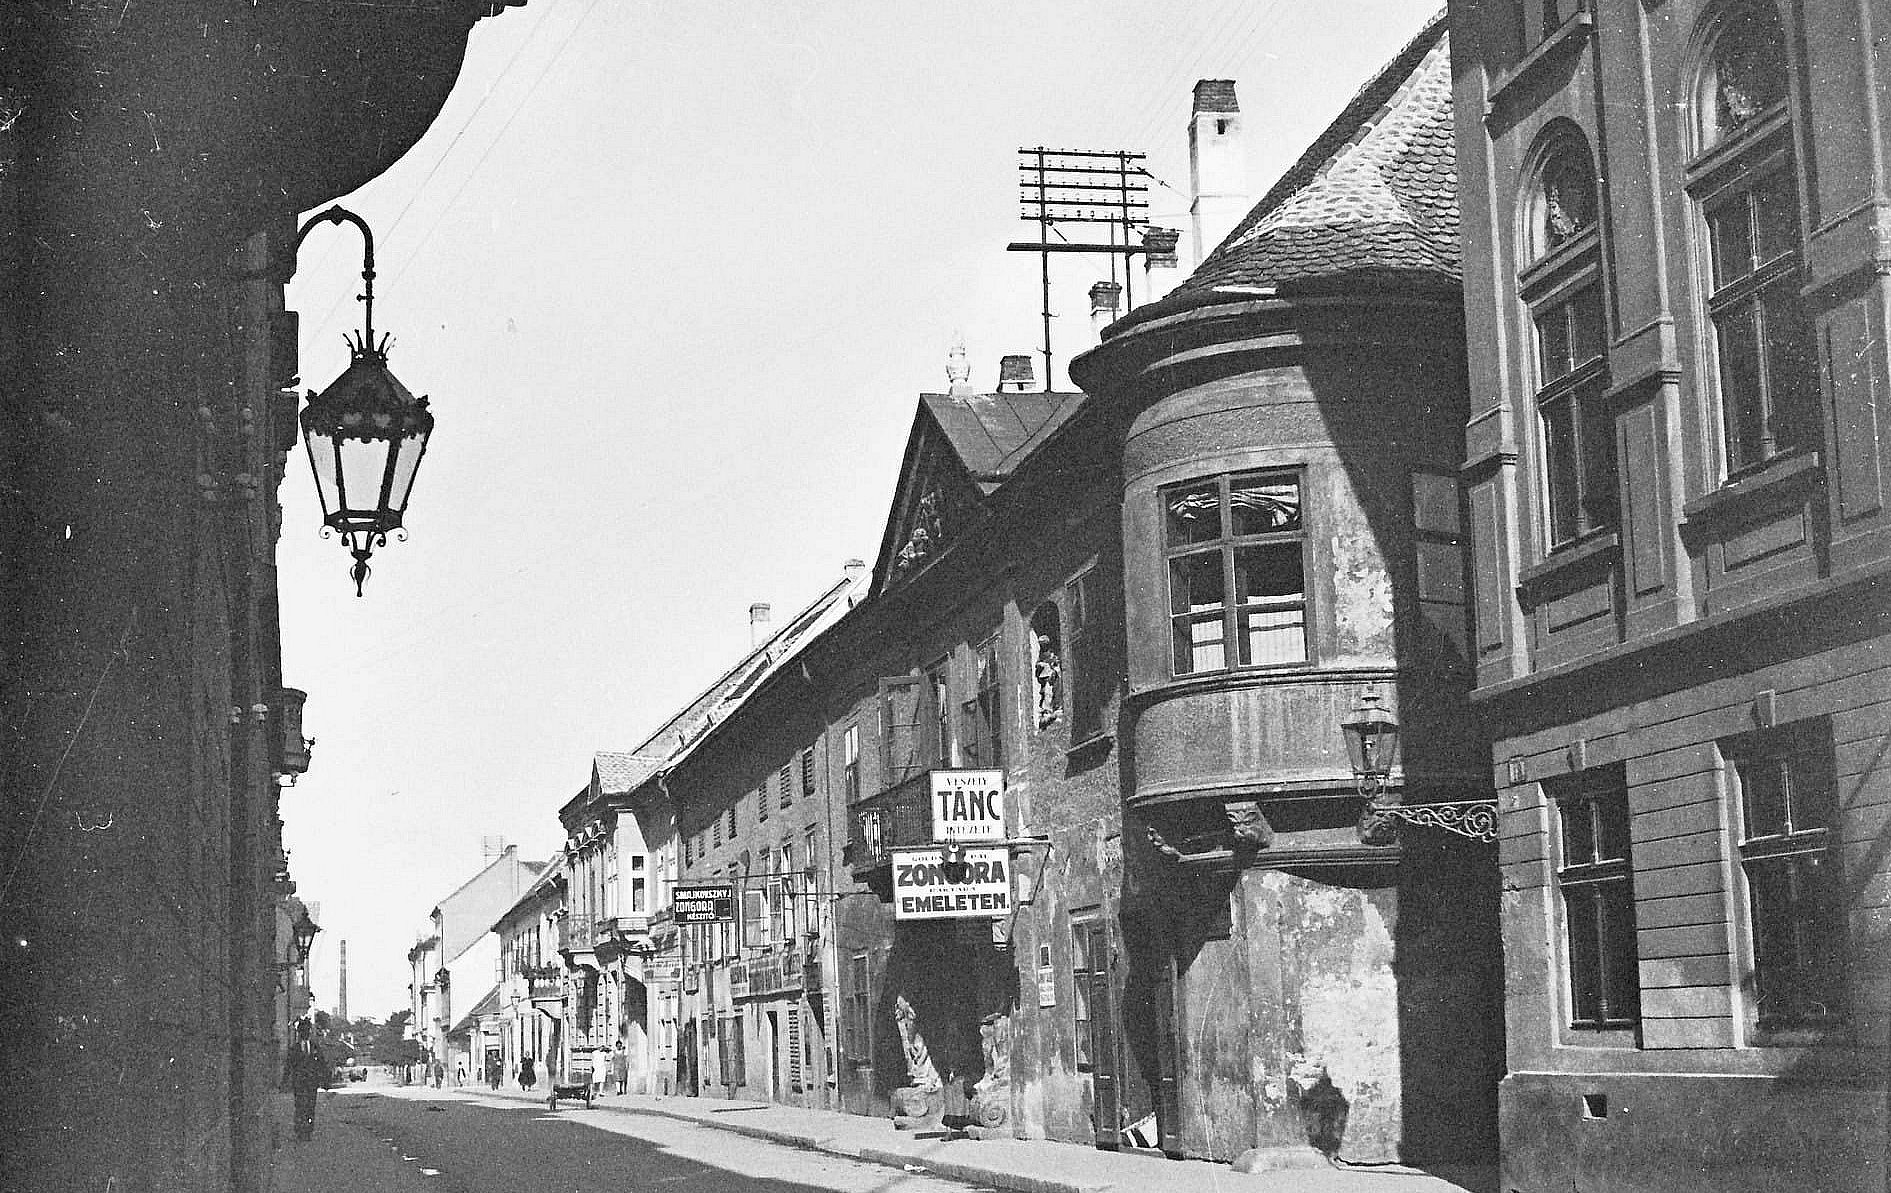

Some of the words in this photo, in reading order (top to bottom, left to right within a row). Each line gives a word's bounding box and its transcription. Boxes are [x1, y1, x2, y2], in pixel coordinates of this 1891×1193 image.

[937, 786, 1001, 821] TÁNC
[897, 861, 1006, 887] ZONORA
[675, 901, 714, 912] ZONGORA
[902, 893, 1010, 913] EMELETEN.
